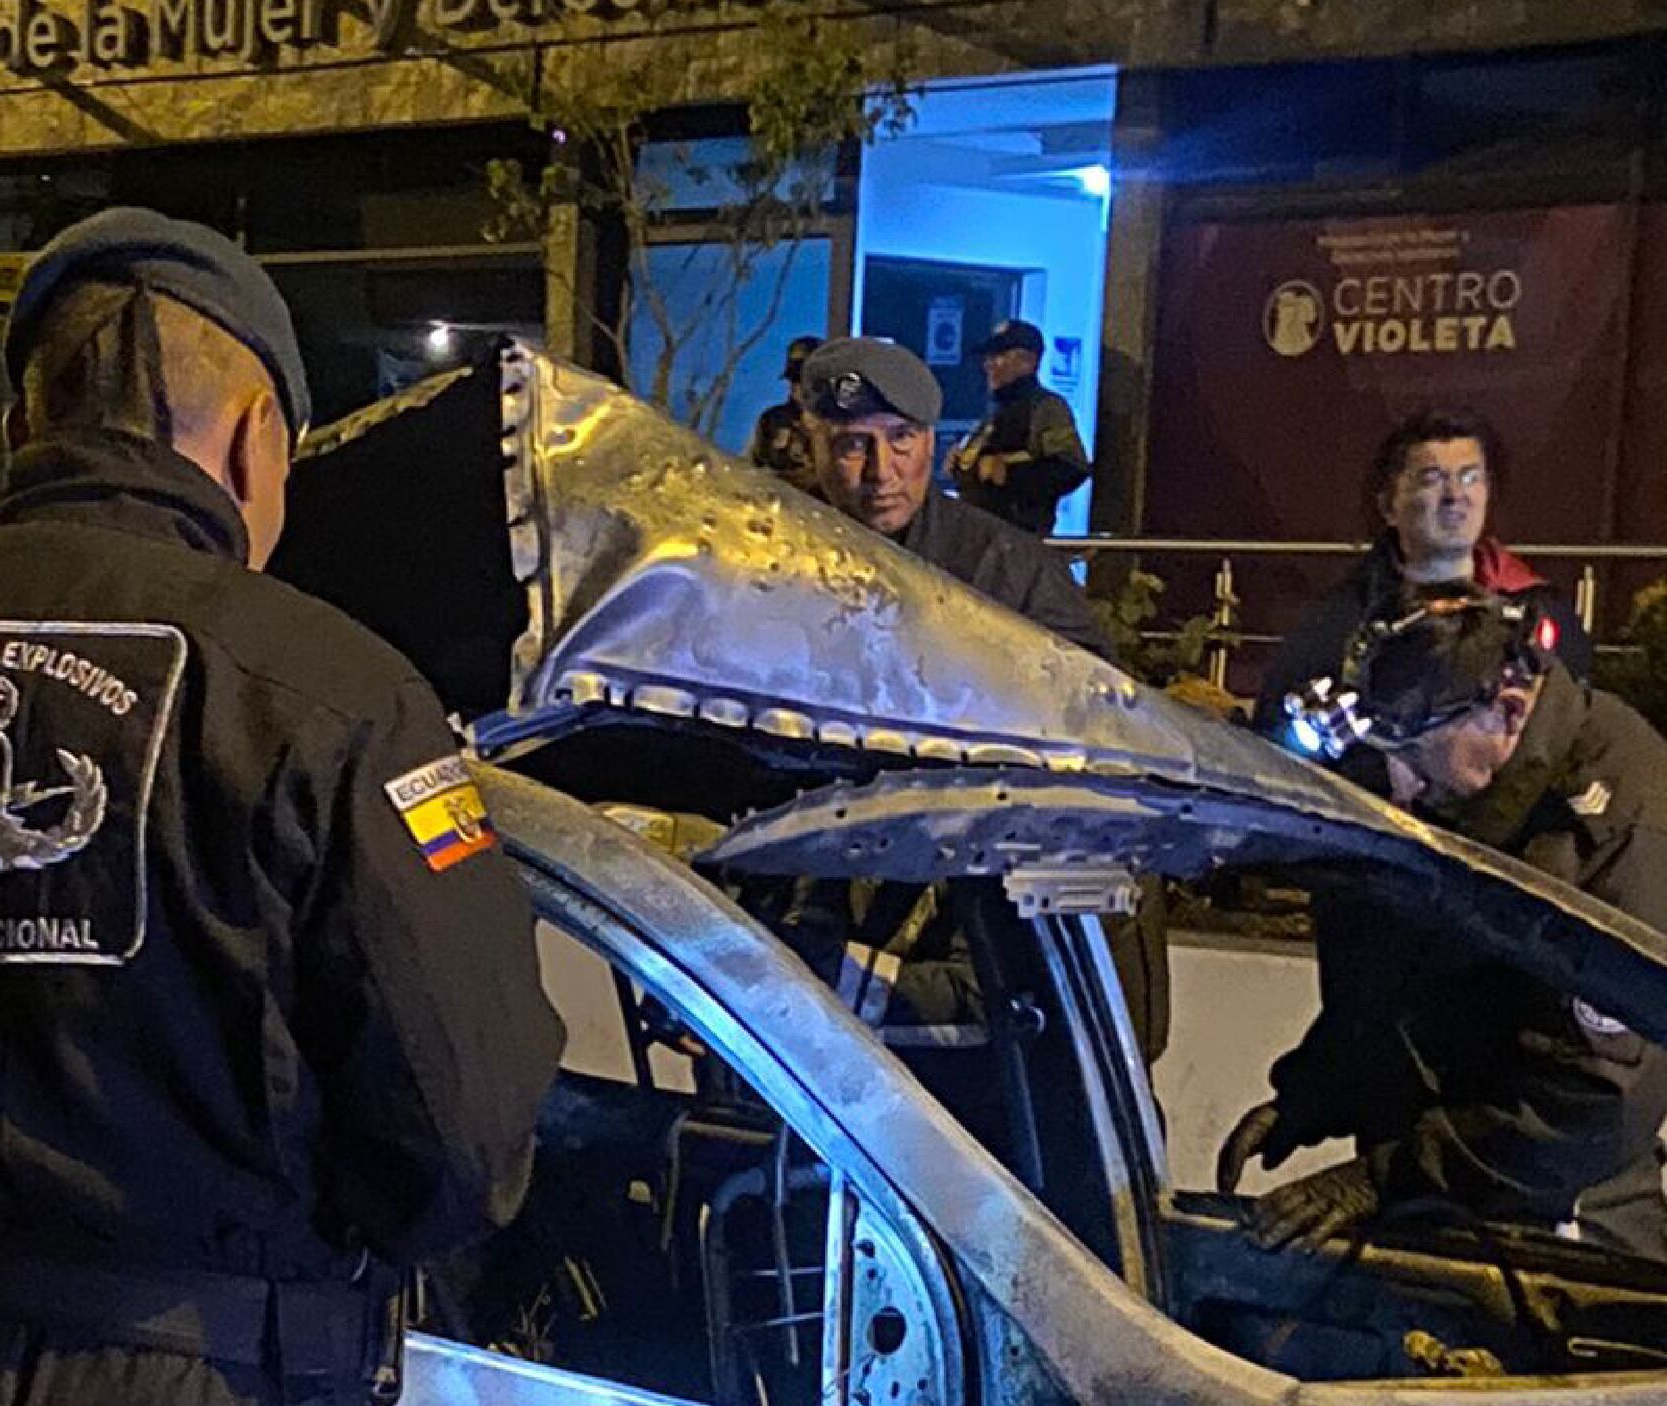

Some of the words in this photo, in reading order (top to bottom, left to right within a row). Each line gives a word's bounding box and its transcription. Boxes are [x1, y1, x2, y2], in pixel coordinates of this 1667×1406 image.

[78, 0, 126, 62] la
[1333, 269, 1522, 316] CENTRO
[1333, 315, 1517, 355] VIOLETA
[1, 640, 139, 716] EXPLOSIVOS
